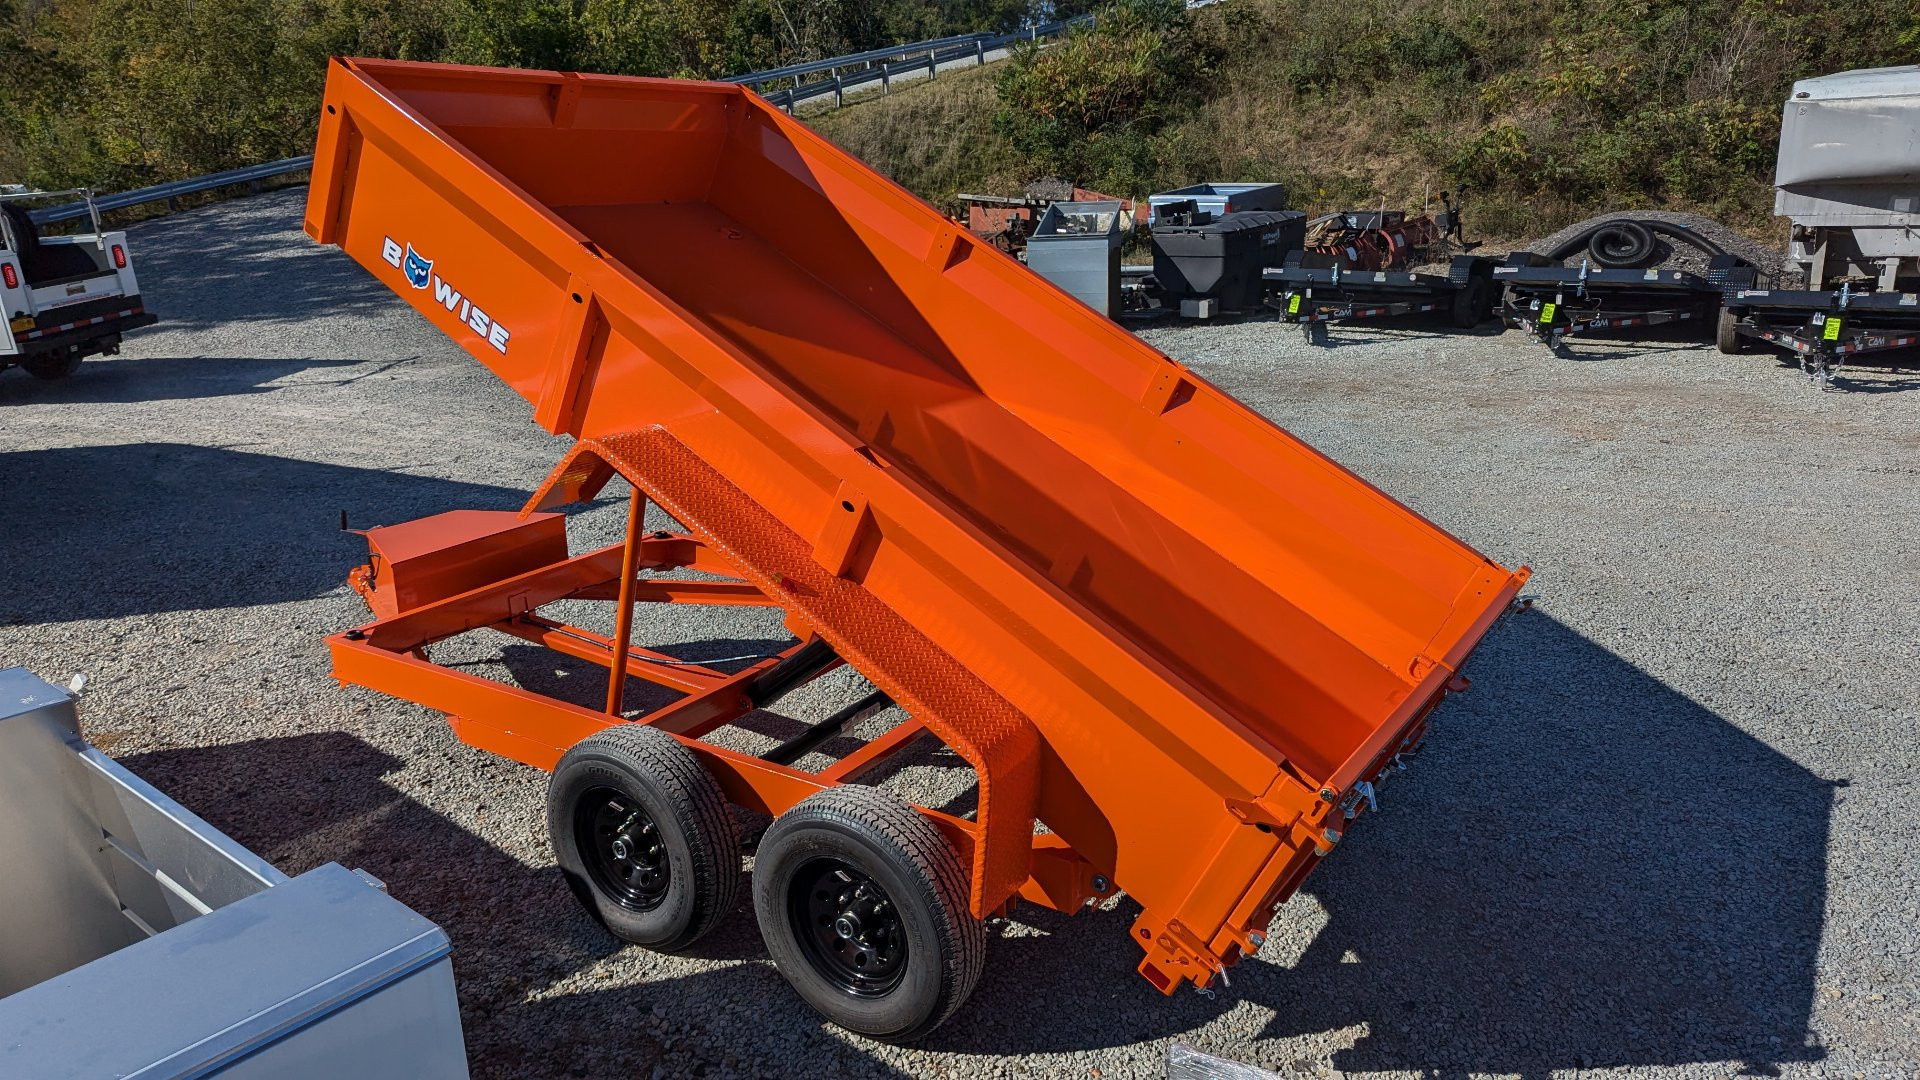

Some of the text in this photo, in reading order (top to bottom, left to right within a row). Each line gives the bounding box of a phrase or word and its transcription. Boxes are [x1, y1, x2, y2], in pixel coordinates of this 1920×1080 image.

[1334, 309, 1351, 317] CAM
[1590, 318, 1608, 327] CAM
[1868, 336, 1885, 346] CAM
